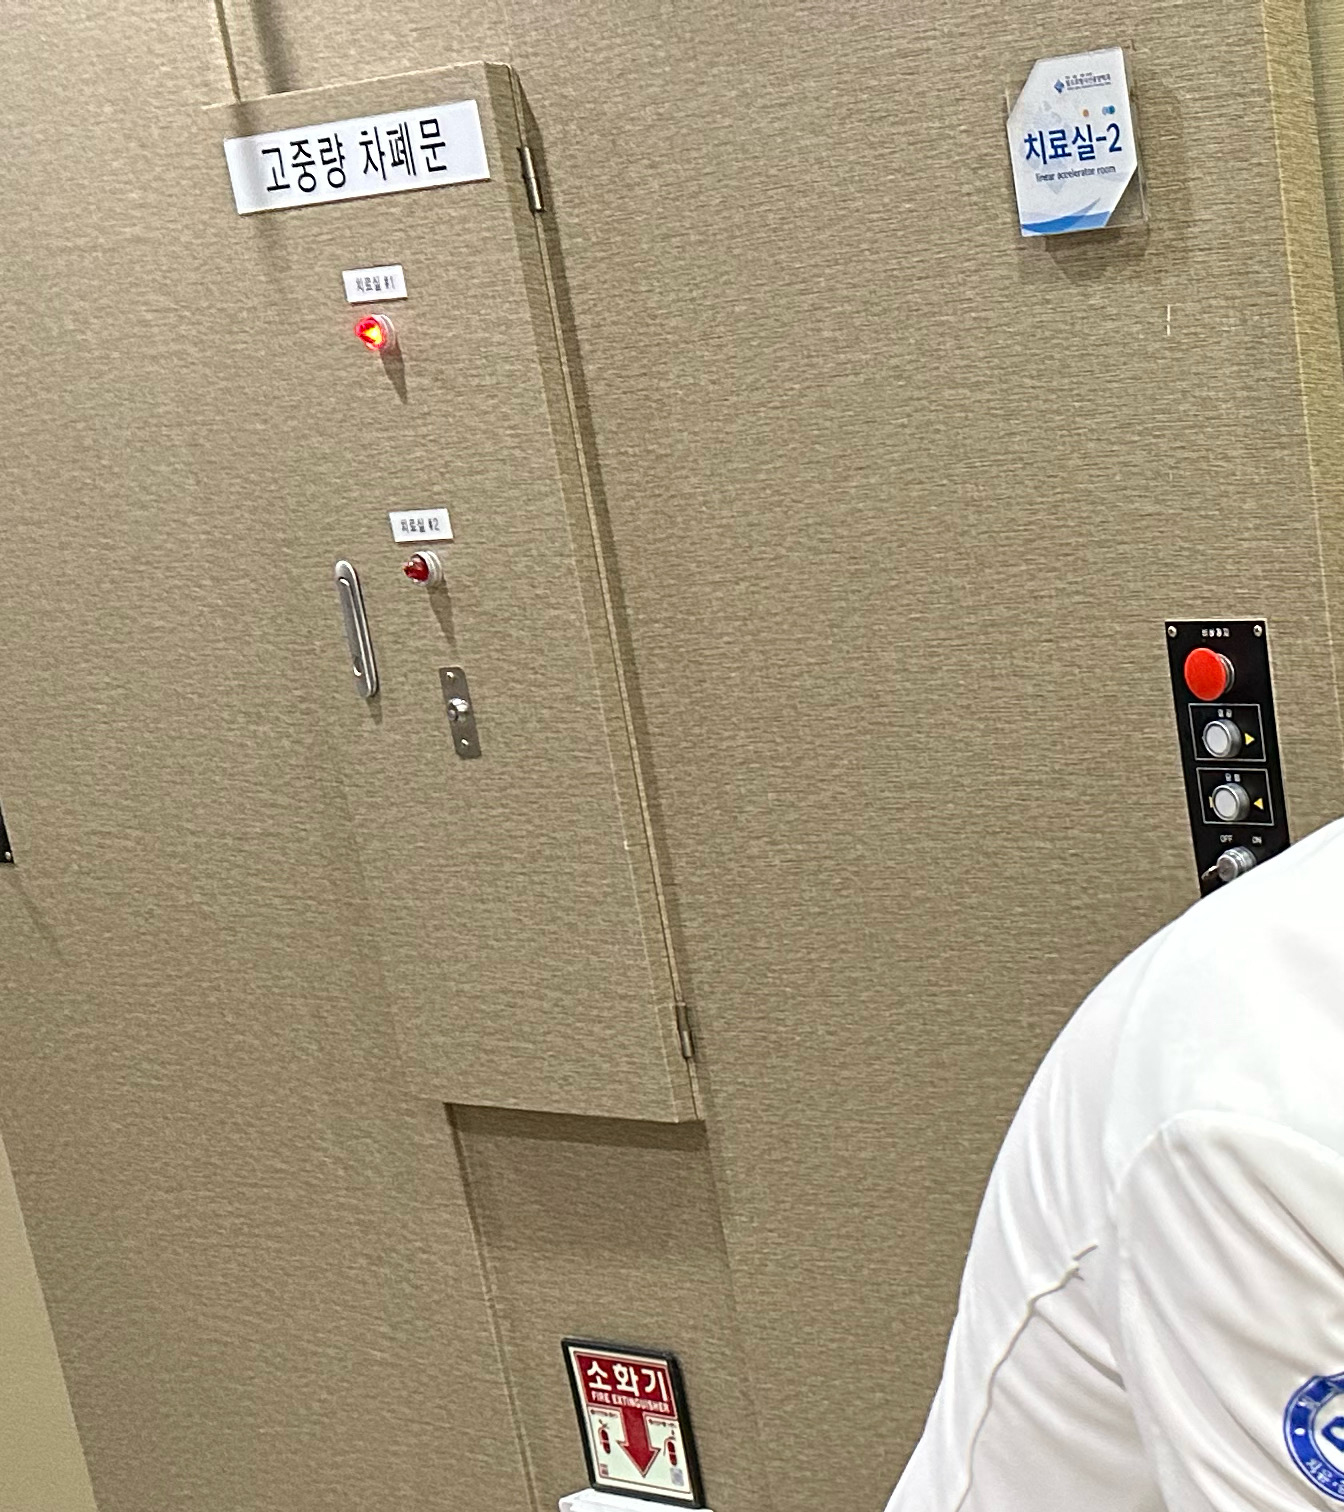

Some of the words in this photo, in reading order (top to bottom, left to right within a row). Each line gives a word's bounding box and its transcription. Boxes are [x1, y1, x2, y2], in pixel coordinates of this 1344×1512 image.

[261, 133, 346, 192] 고중량
[359, 118, 448, 181] 차폐문
[1024, 123, 1122, 165] 치료실-2
[1096, 165, 1116, 175] room
[586, 1360, 668, 1401] 소화기
[591, 1390, 611, 1404] FIRE
[611, 1391, 671, 1414] EXTINGUISHER
